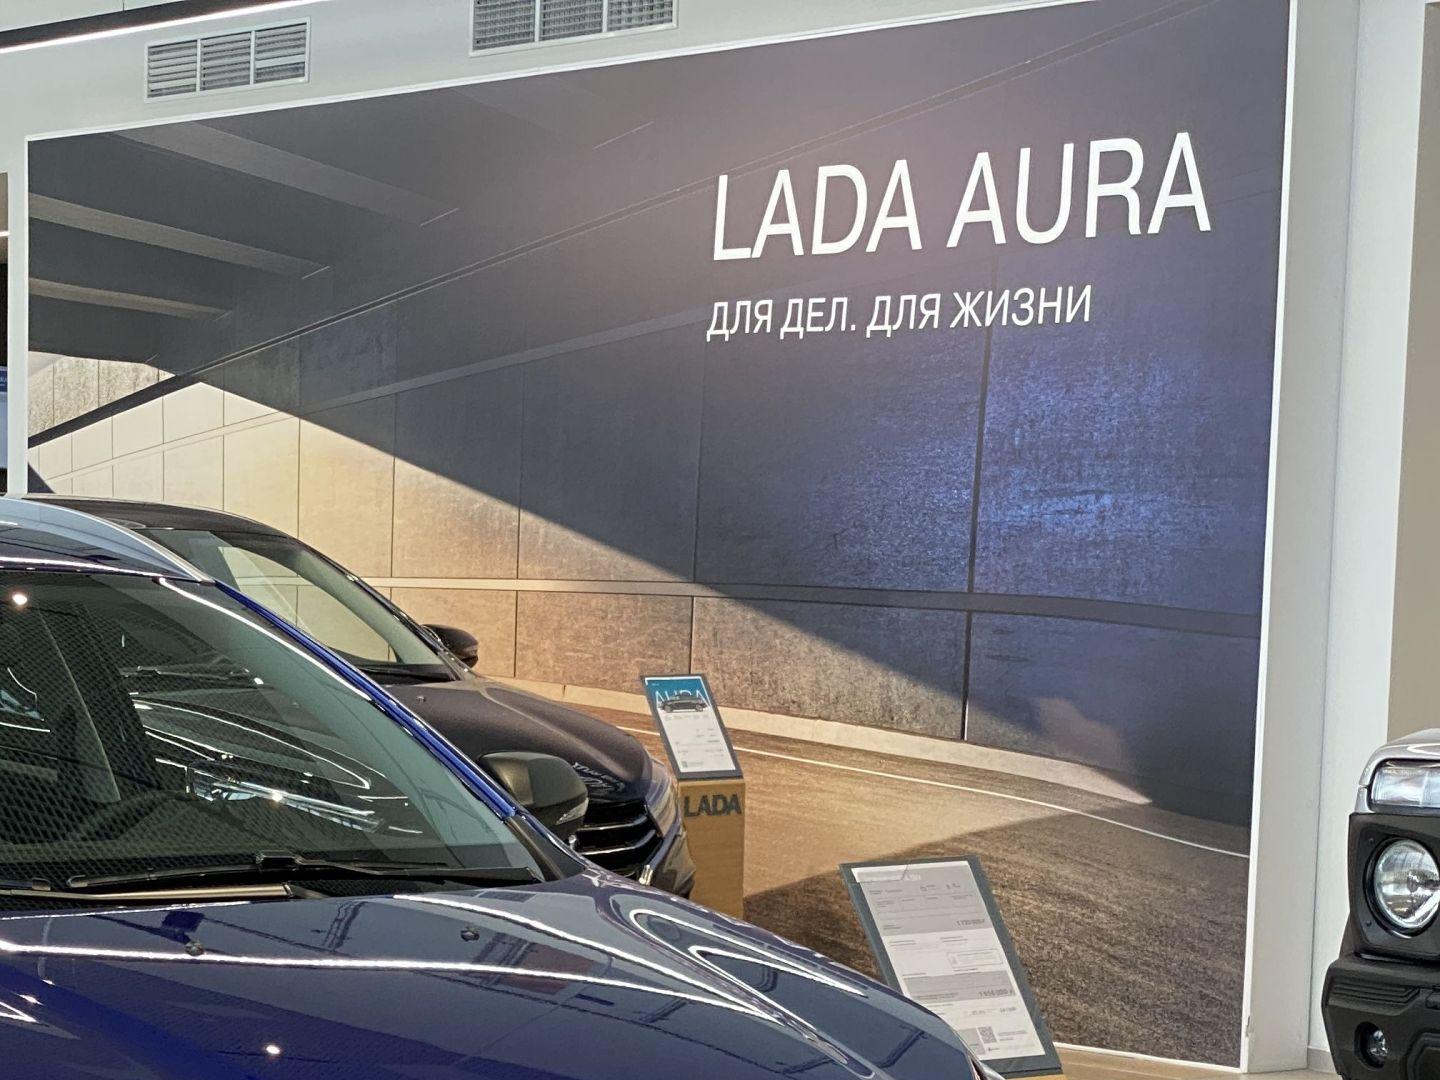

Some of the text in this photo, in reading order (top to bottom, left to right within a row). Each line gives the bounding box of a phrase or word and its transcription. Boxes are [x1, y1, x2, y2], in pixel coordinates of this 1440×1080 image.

[713, 132, 1212, 261] LADA AURA
[706, 284, 1093, 342] ДЛЯ ДЕЛ. ДЛЯ ЖИЗНИ
[684, 794, 742, 817] LADA
